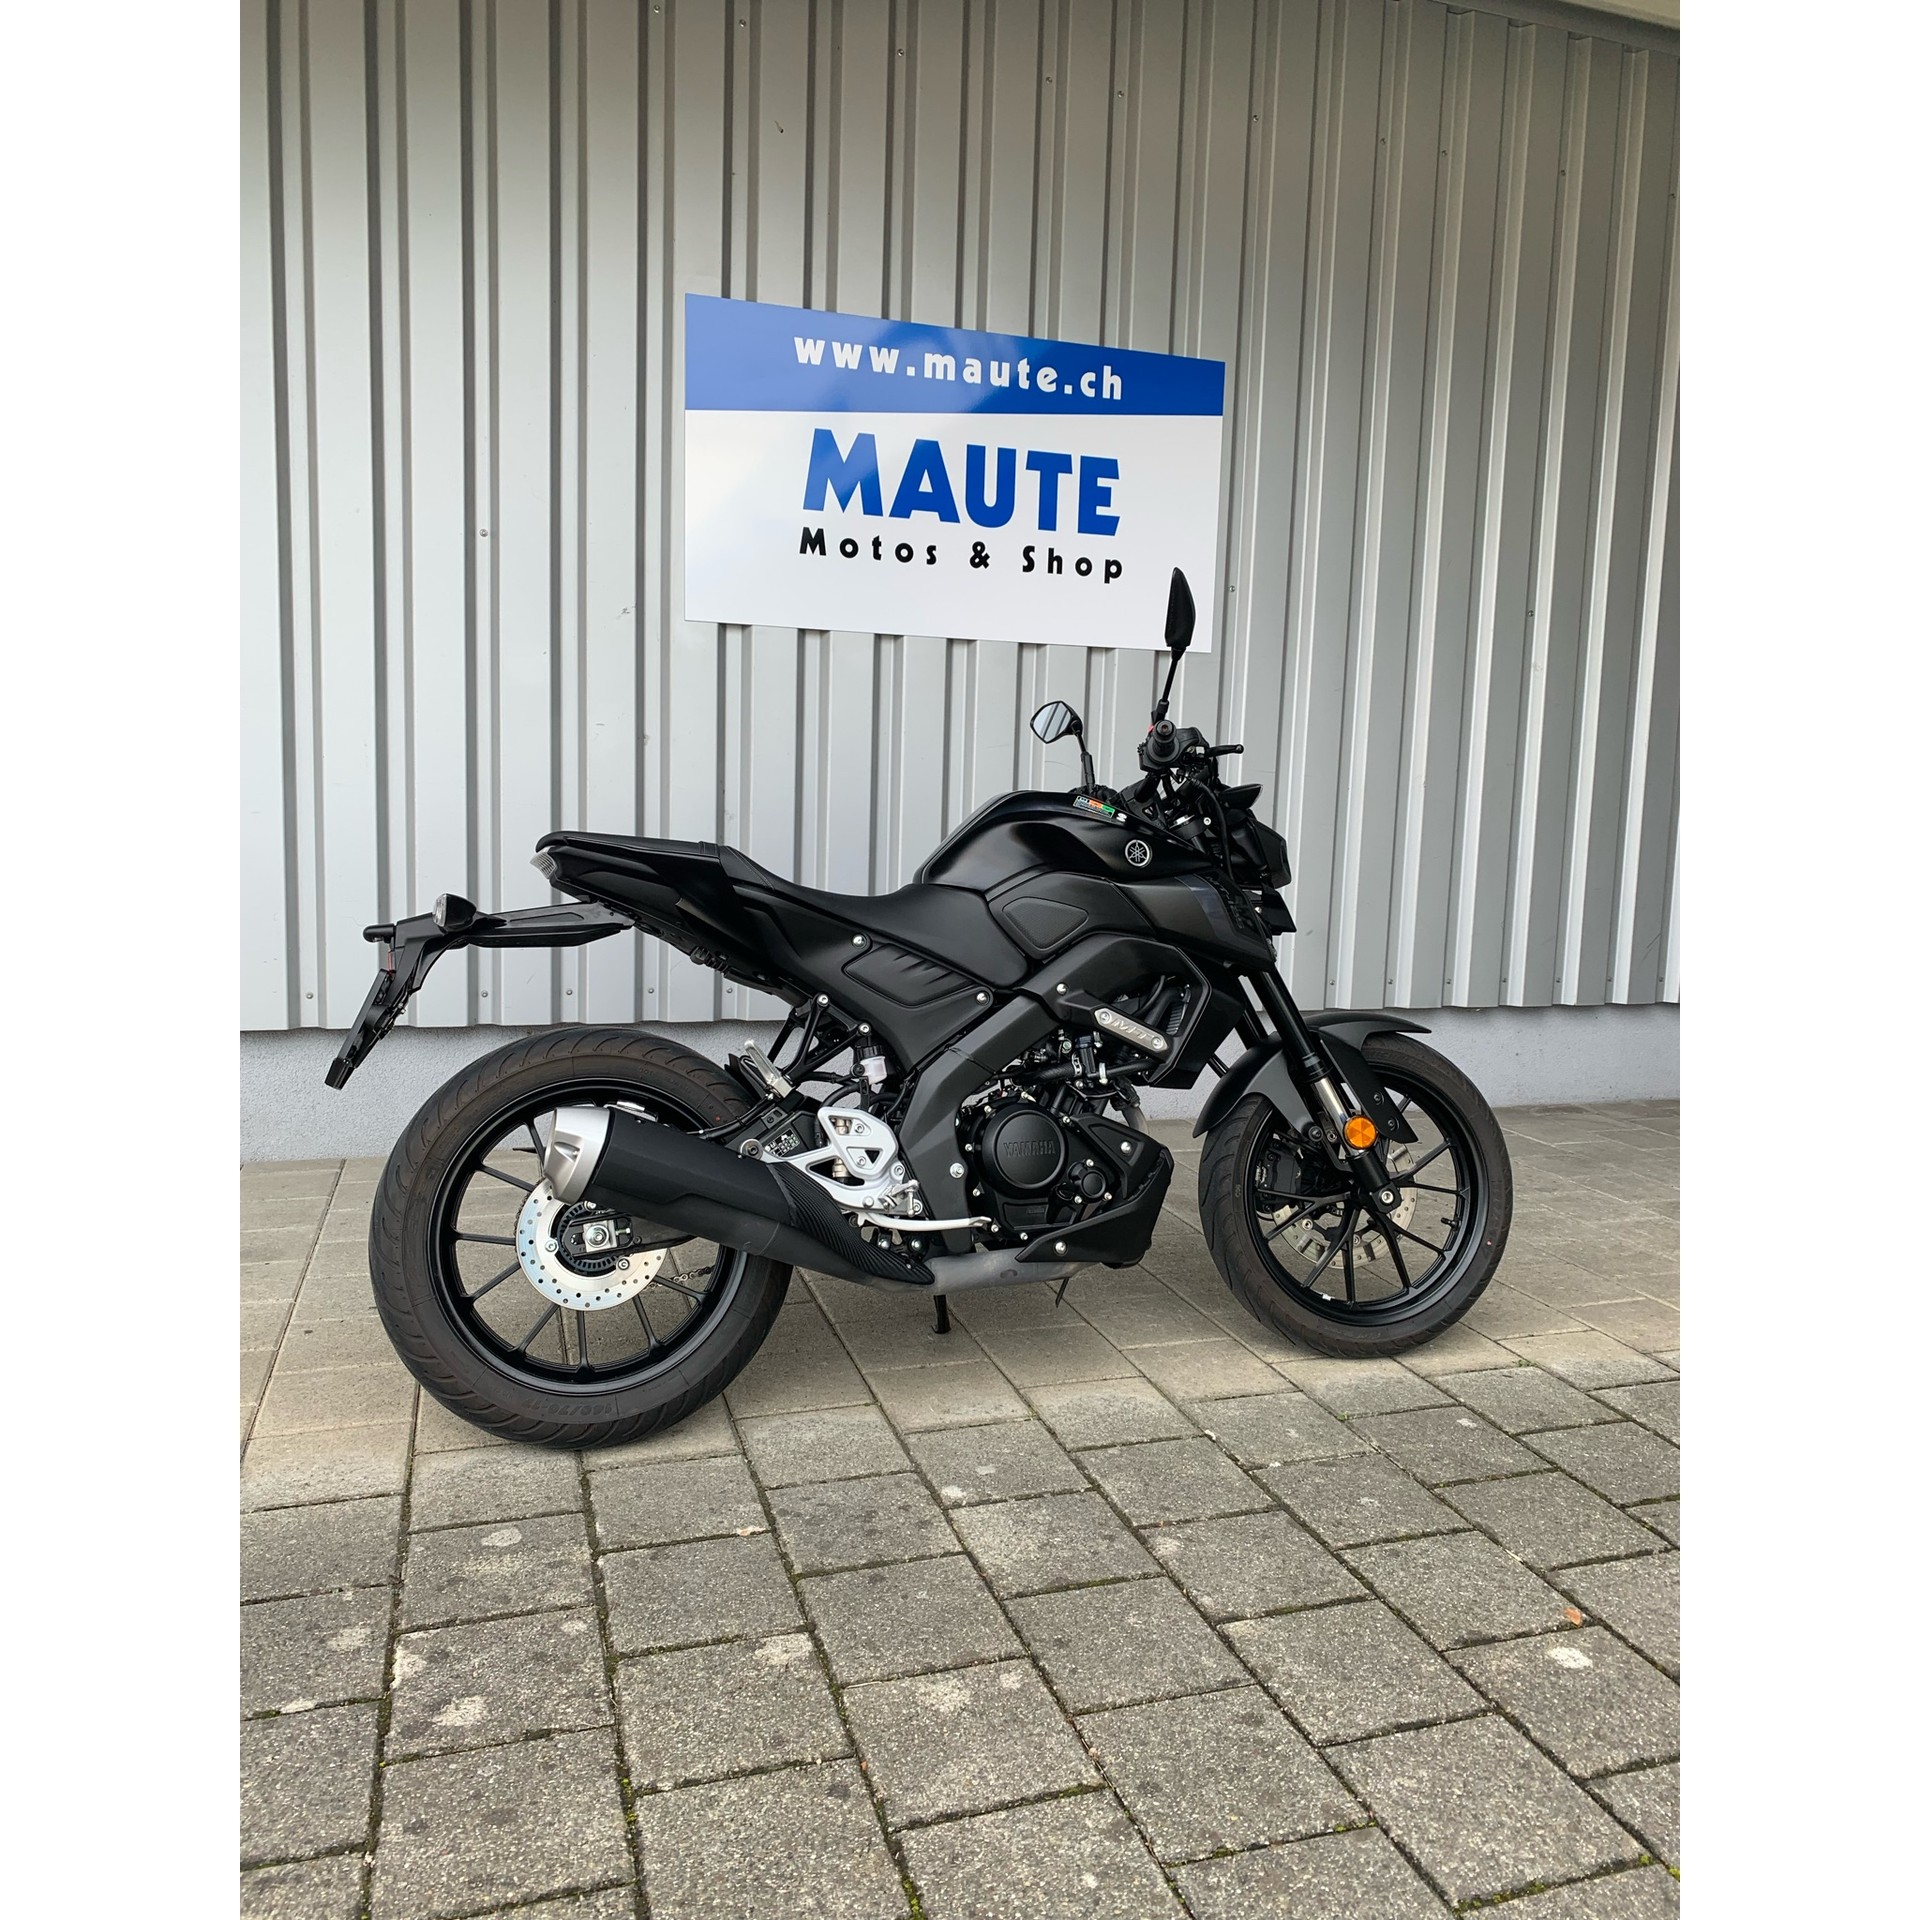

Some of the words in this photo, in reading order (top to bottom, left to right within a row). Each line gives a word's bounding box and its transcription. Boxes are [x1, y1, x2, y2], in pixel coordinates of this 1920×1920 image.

[794, 336, 1123, 400] www.maute.ch
[802, 427, 1121, 537] MAUTE
[799, 526, 938, 566] Motos
[969, 541, 991, 569] &
[1022, 545, 1123, 584] Shop
[1002, 1140, 1057, 1158] YAMAHA
